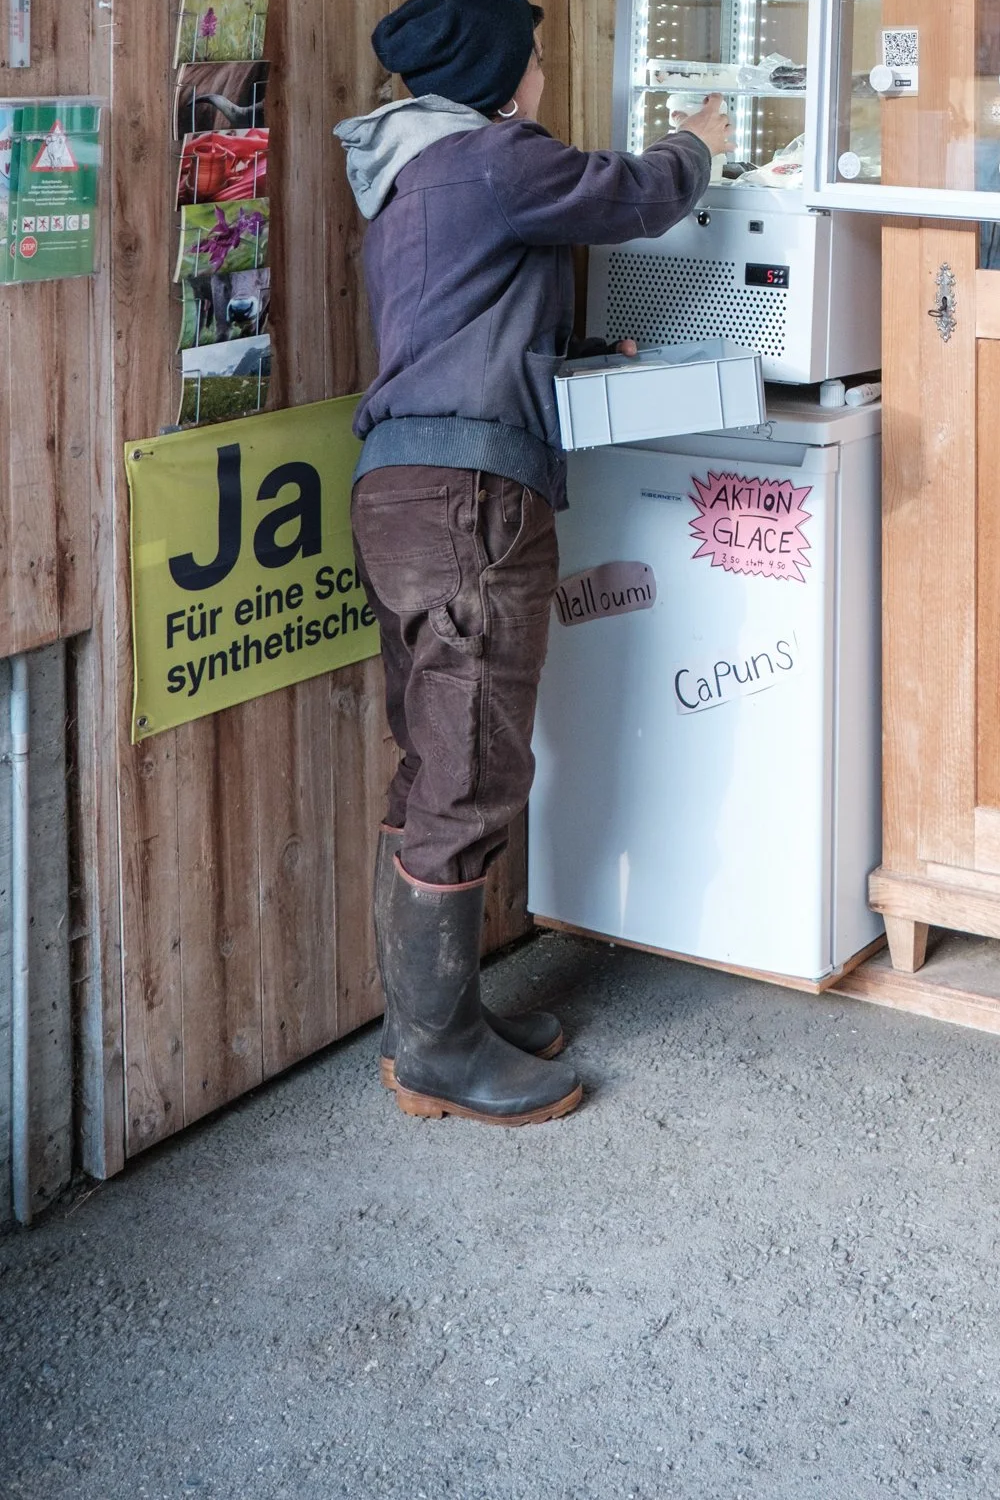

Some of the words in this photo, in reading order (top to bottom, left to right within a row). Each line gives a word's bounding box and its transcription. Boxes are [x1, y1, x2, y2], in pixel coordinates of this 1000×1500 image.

[767, 270, 774, 283] 5
[168, 442, 323, 592] Ja
[709, 484, 793, 515] AKTION
[712, 517, 794, 554] GLACE
[166, 603, 223, 649] Für
[234, 582, 304, 626] eine
[555, 566, 652, 623] Halloumi
[166, 602, 377, 697] synthetische
